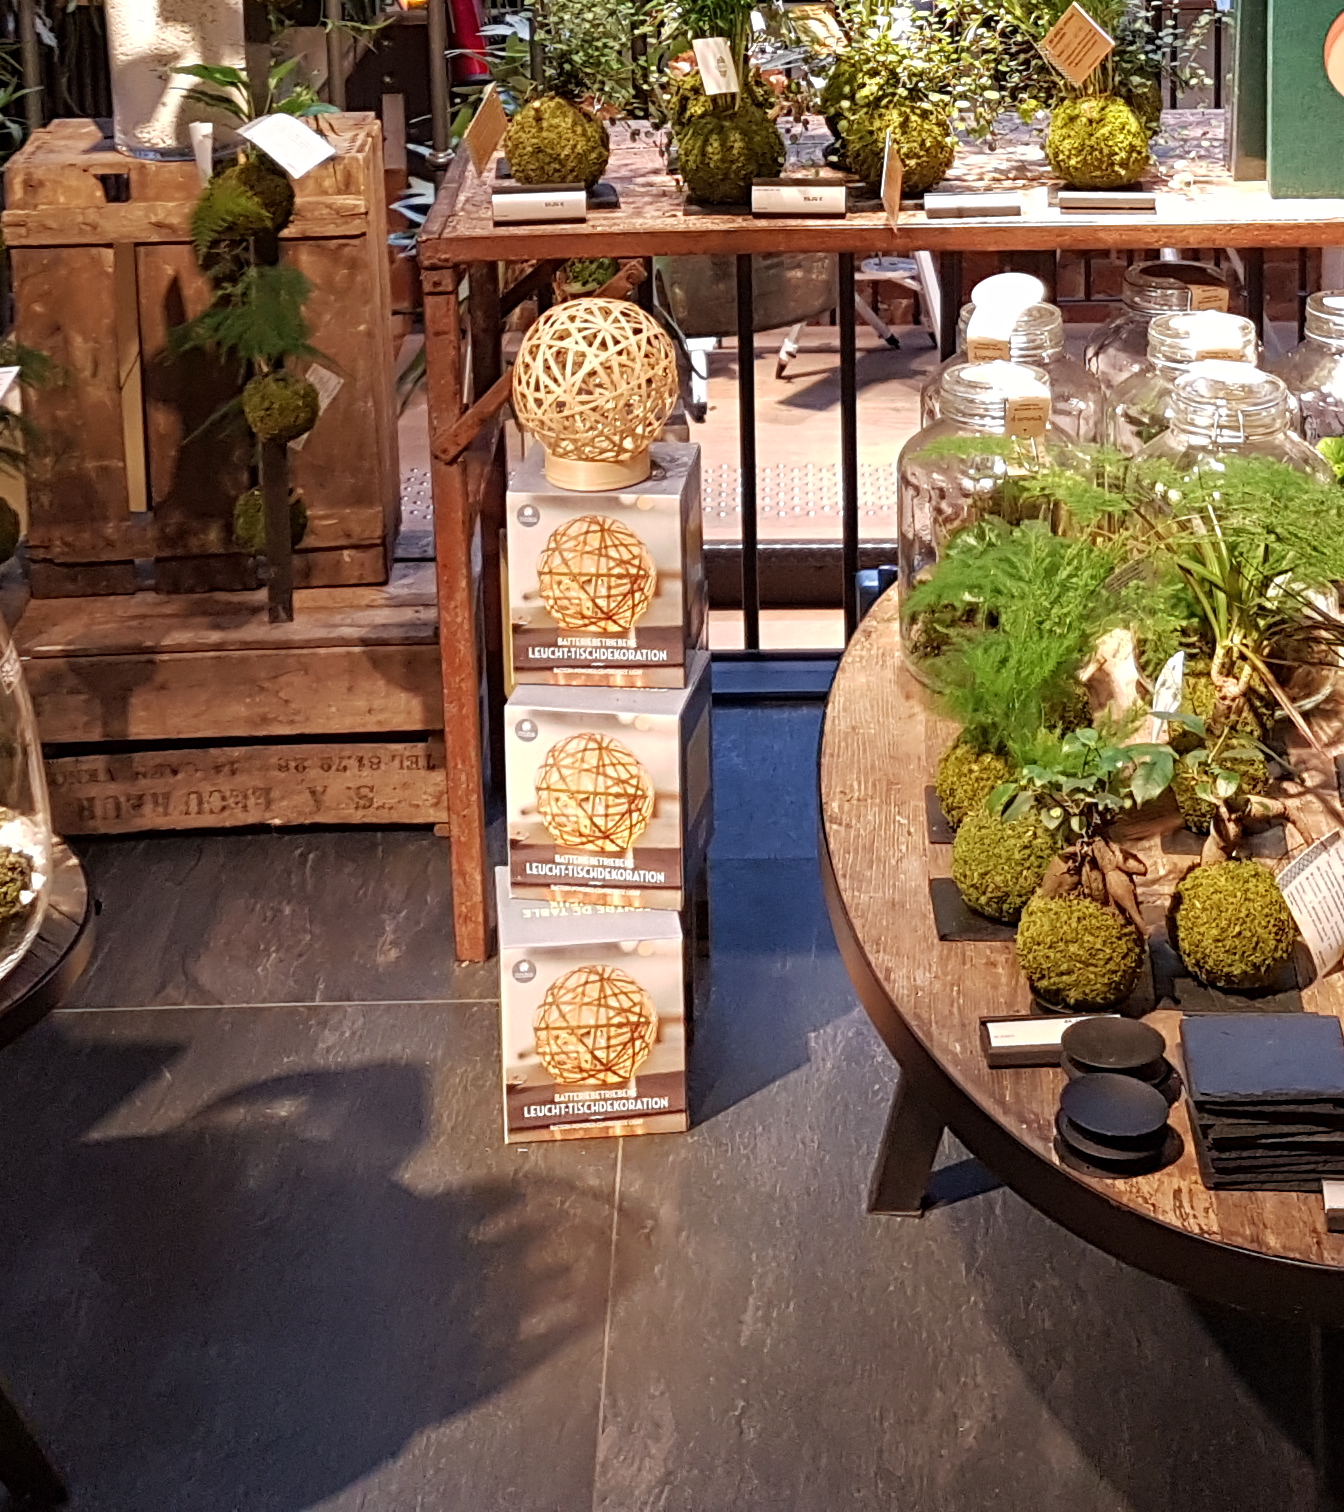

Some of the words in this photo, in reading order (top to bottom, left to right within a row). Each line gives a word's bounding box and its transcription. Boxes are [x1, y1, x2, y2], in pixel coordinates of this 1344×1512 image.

[528, 646, 668, 661] LEUCHT-TISCHDEKORATION
[526, 862, 665, 883] LEUCHT-TISCHDEKORATION
[524, 1096, 669, 1118] LEUCHT-TISCHDEKORATION
